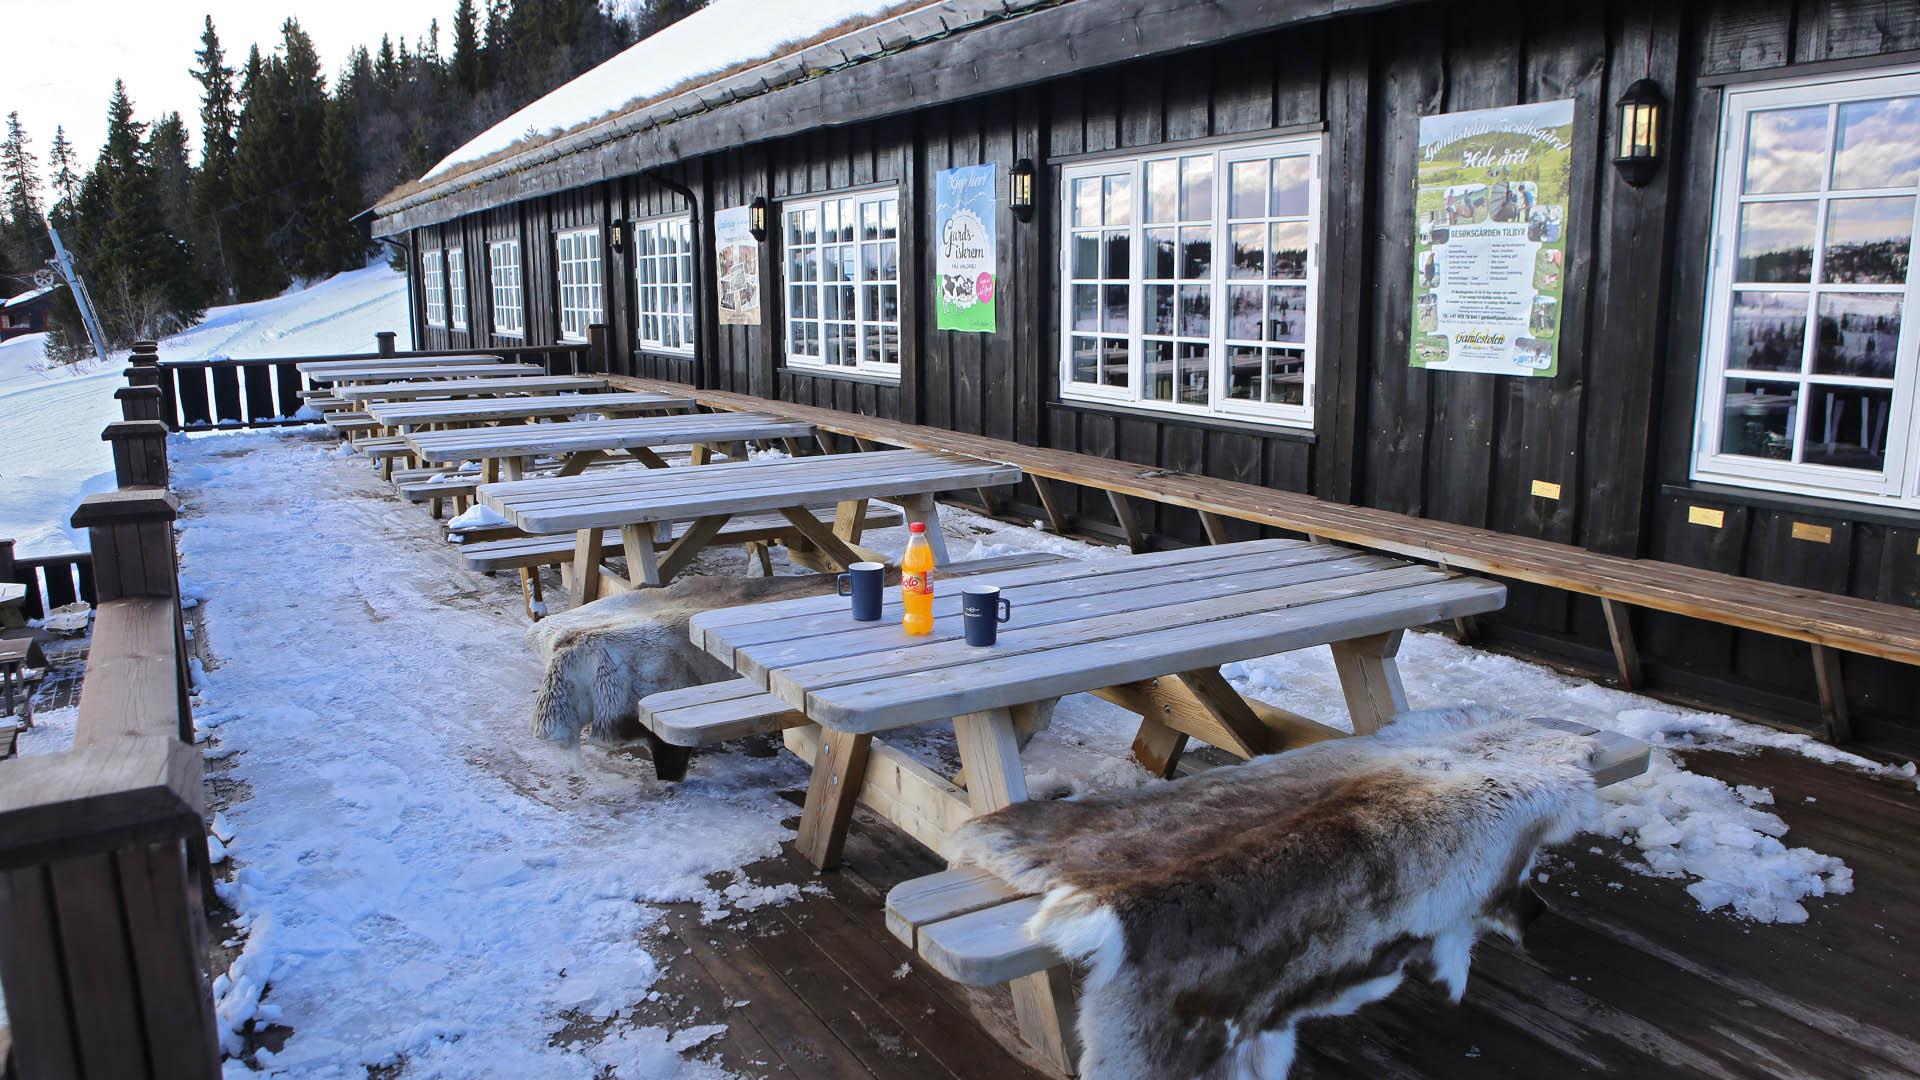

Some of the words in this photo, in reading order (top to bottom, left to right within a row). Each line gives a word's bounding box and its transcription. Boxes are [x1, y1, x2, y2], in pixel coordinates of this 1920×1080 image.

[1463, 146, 1495, 169] Hele
[1497, 149, 1530, 167] året
[943, 218, 975, 258] Gards-
[1451, 228, 1501, 238] BESØKSGÅRDEN
[1503, 227, 1526, 236] TILBYR
[955, 243, 984, 260] iskrem
